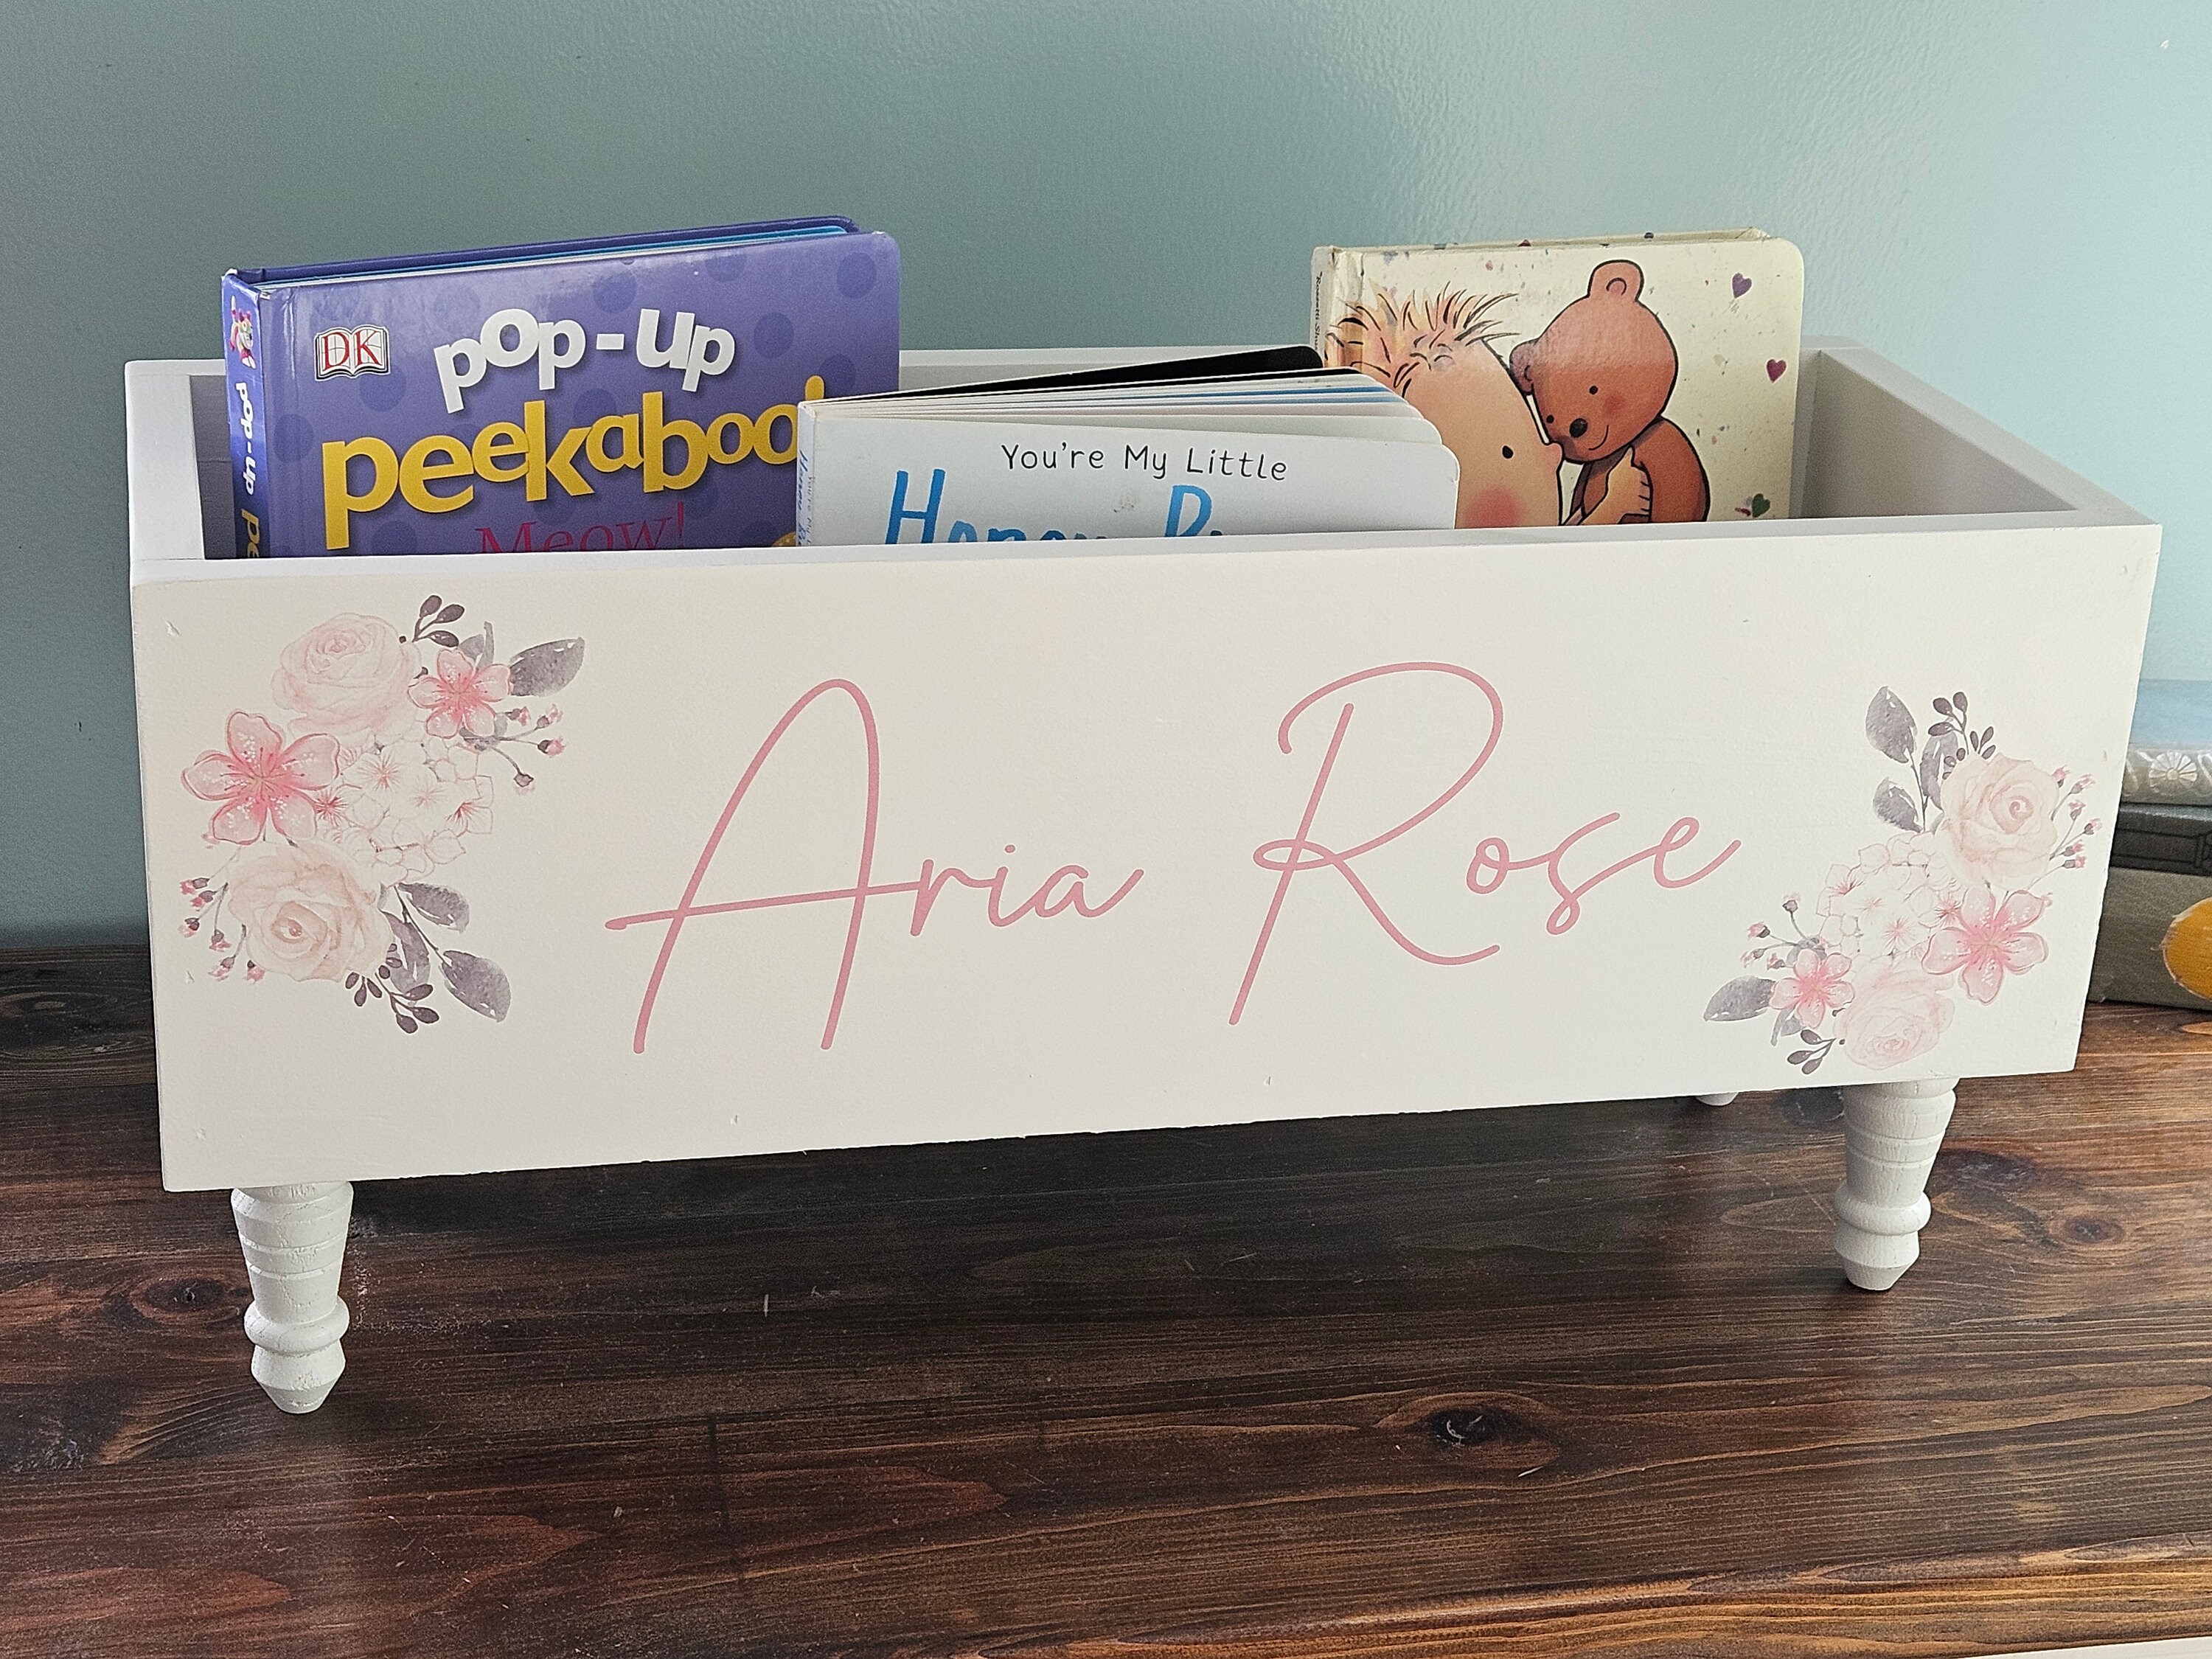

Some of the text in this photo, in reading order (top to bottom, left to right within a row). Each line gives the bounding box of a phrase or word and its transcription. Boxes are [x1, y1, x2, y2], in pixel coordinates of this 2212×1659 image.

[321, 330, 383, 372] DK
[434, 307, 736, 414] pop-up
[235, 381, 257, 495] pop-up
[1001, 442, 1288, 481] You're My Little
[605, 661, 1742, 1054] Aria Rose
